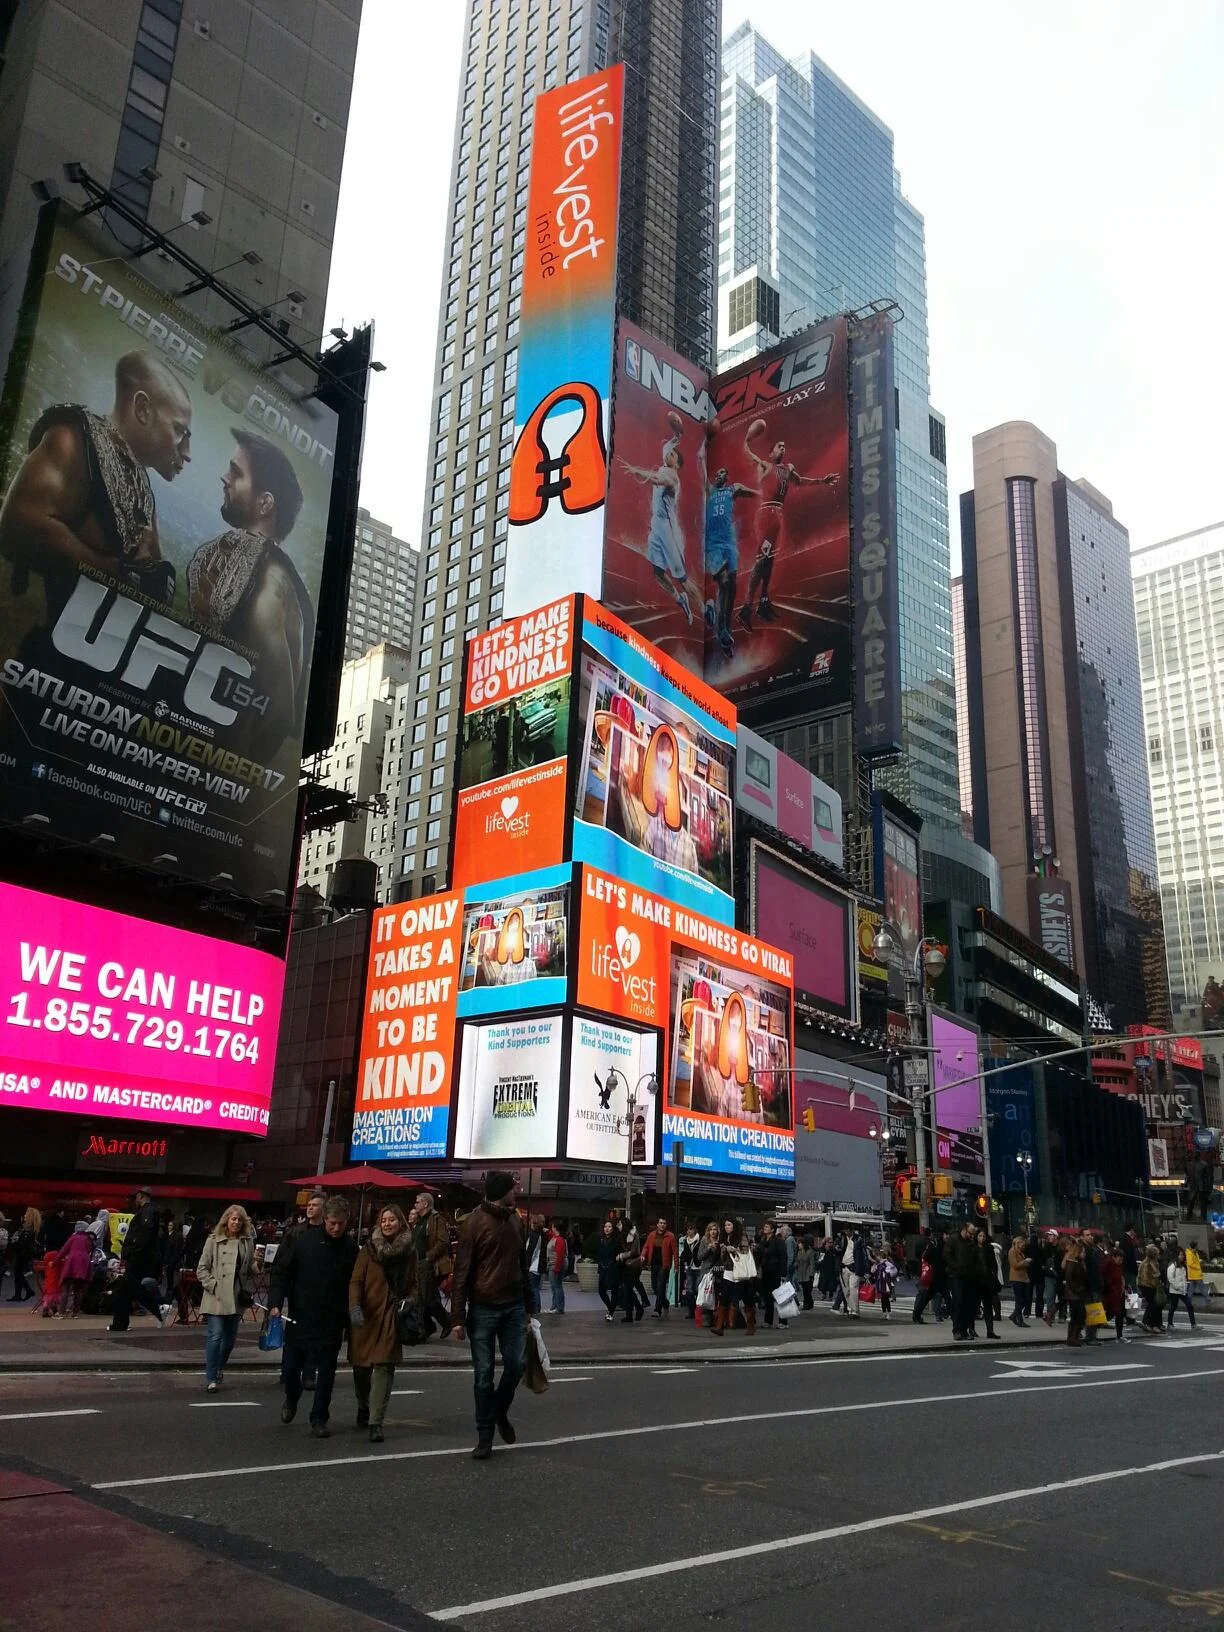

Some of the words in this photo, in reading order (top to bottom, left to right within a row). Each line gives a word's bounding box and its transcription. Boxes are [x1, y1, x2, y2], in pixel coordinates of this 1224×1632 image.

[535, 211, 560, 279] inside
[55, 253, 204, 367] ST-PIERRE
[246, 394, 333, 466] CONDIT
[640, 348, 718, 423] NBA
[715, 335, 832, 422] 2K13
[783, 387, 813, 408] JAY
[814, 381, 825, 394] Z
[857, 349, 882, 495] TIMES
[859, 512, 886, 702] SQUARE
[473, 626, 514, 659] LET'S
[520, 601, 569, 638] MAKE
[51, 574, 252, 727] UFC
[472, 623, 569, 683] KINDNESS
[596, 615, 628, 642] because
[628, 635, 661, 672] kindness
[661, 665, 680, 690] keeps
[680, 685, 692, 701] the
[692, 695, 711, 716] world
[223, 676, 271, 716] 154
[470, 677, 500, 704] GO
[507, 649, 567, 688] VIRAL
[0, 658, 143, 733] SATURDAY
[136, 716, 266, 787] NOVEMBER
[263, 768, 285, 792] 17
[170, 711, 215, 735] MARINES
[39, 707, 92, 743] LIVE
[89, 730, 123, 757] ON
[122, 741, 250, 804] PAY-PER-VIEW
[48, 767, 152, 815] facebook.com/UFC
[87, 763, 107, 776] ALSO
[107, 768, 144, 790] AVAILABLE
[172, 808, 243, 847] twitter.com/ufc
[510, 829, 530, 840] inside
[376, 914, 396, 943] IT
[400, 899, 459, 933] ONLY
[586, 874, 627, 909] LET'S
[631, 893, 671, 928] MAKE
[675, 912, 738, 956] KINDNESS
[741, 939, 758, 963] GO
[761, 949, 791, 978] VIRAL
[1039, 892, 1070, 967] SHEY'S
[374, 942, 433, 977] TAKES
[437, 938, 454, 965] A
[20, 941, 86, 992] WE
[97, 961, 176, 1010] CAN
[186, 980, 264, 1027] HELP
[369, 976, 452, 1014] MOMENT
[6, 991, 259, 1065] 1.855.729.1764
[630, 1002, 656, 1018] inside
[377, 1018, 406, 1048] TO
[411, 1013, 438, 1043] BE
[488, 1027, 510, 1038] Thank
[512, 1026, 525, 1037] you
[528, 1025, 536, 1034] to
[538, 1024, 552, 1032] our
[488, 1040, 504, 1050] Kind
[506, 1035, 550, 1049] Supporters
[581, 1022, 600, 1037] Thank
[601, 1030, 614, 1042] you
[614, 1032, 622, 1042] to
[623, 1035, 633, 1044] our
[581, 1036, 597, 1048] Kind
[597, 1039, 632, 1057] Supporters
[362, 1050, 446, 1102] KIND
[493, 1081, 538, 1106] EXTREME
[49, 1079, 88, 1101] AND
[219, 1101, 259, 1121] CREDIT
[353, 1107, 433, 1130] IMAGINATION
[494, 1110, 535, 1119] PRODUCTIONS
[575, 1109, 612, 1123] AMERICAN
[82, 1135, 167, 1157] Marriott
[351, 1124, 420, 1146] CREATIONS
[662, 1113, 738, 1144] IMAGINATION
[740, 1128, 794, 1153] CREATIONS
